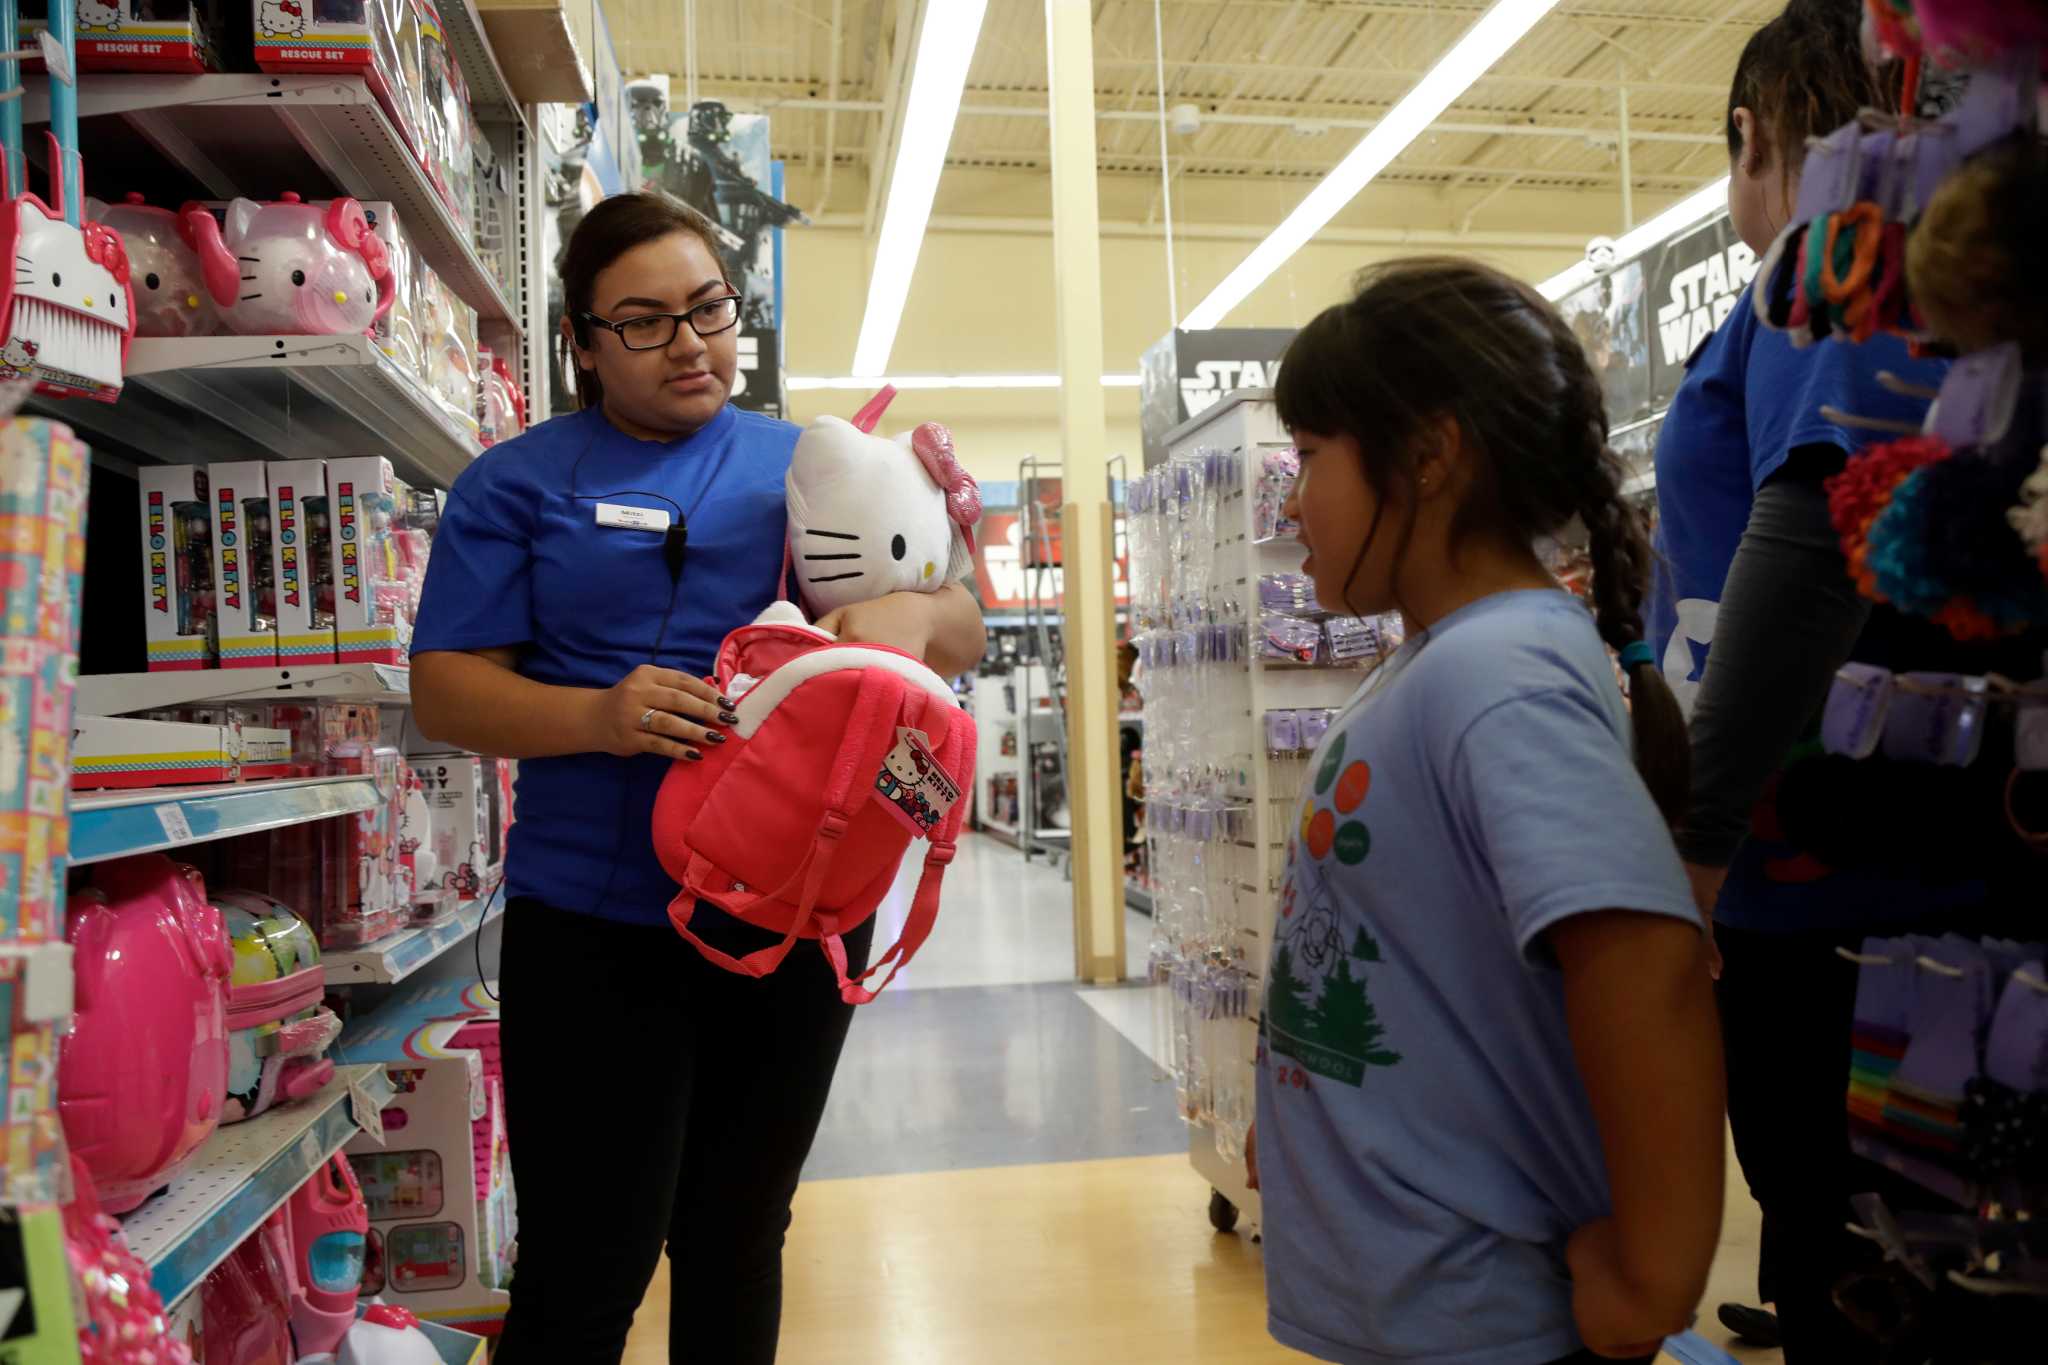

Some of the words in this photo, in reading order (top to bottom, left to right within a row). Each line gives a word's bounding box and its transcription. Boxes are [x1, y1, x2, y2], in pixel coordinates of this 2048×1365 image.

[96, 43, 138, 53] RESCUE
[142, 44, 162, 54] SET
[280, 50, 322, 59] RESCUE
[325, 51, 345, 60] SET
[1658, 241, 1762, 325] STAR
[1659, 294, 1738, 366] WAR
[148, 491, 166, 550] HELLO
[218, 488, 237, 547] HELLO
[278, 486, 296, 545] HELLO
[338, 482, 355, 541] HELLO
[151, 552, 168, 613] KITTY
[222, 548, 241, 609] KITTY
[281, 547, 300, 607] KITTY
[341, 542, 360, 603] KITTY
[927, 775, 951, 802] KITTY
[931, 771, 954, 799] HELLO
